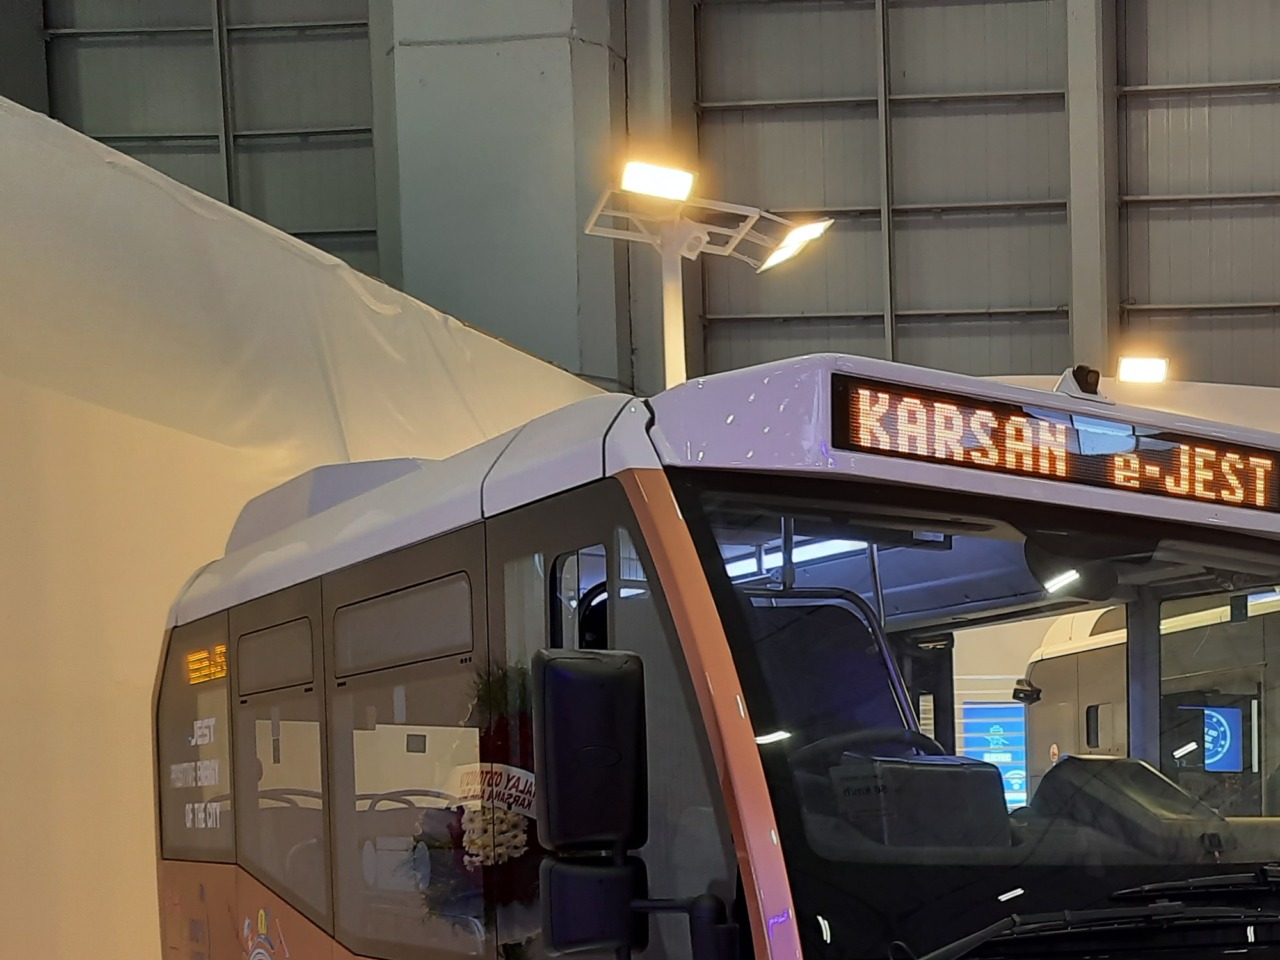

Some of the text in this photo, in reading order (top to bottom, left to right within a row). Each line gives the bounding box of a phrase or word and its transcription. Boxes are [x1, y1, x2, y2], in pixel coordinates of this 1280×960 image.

[856, 388, 1274, 507] KARSAN e-JEST
[185, 802, 221, 829] OF THE CITY
